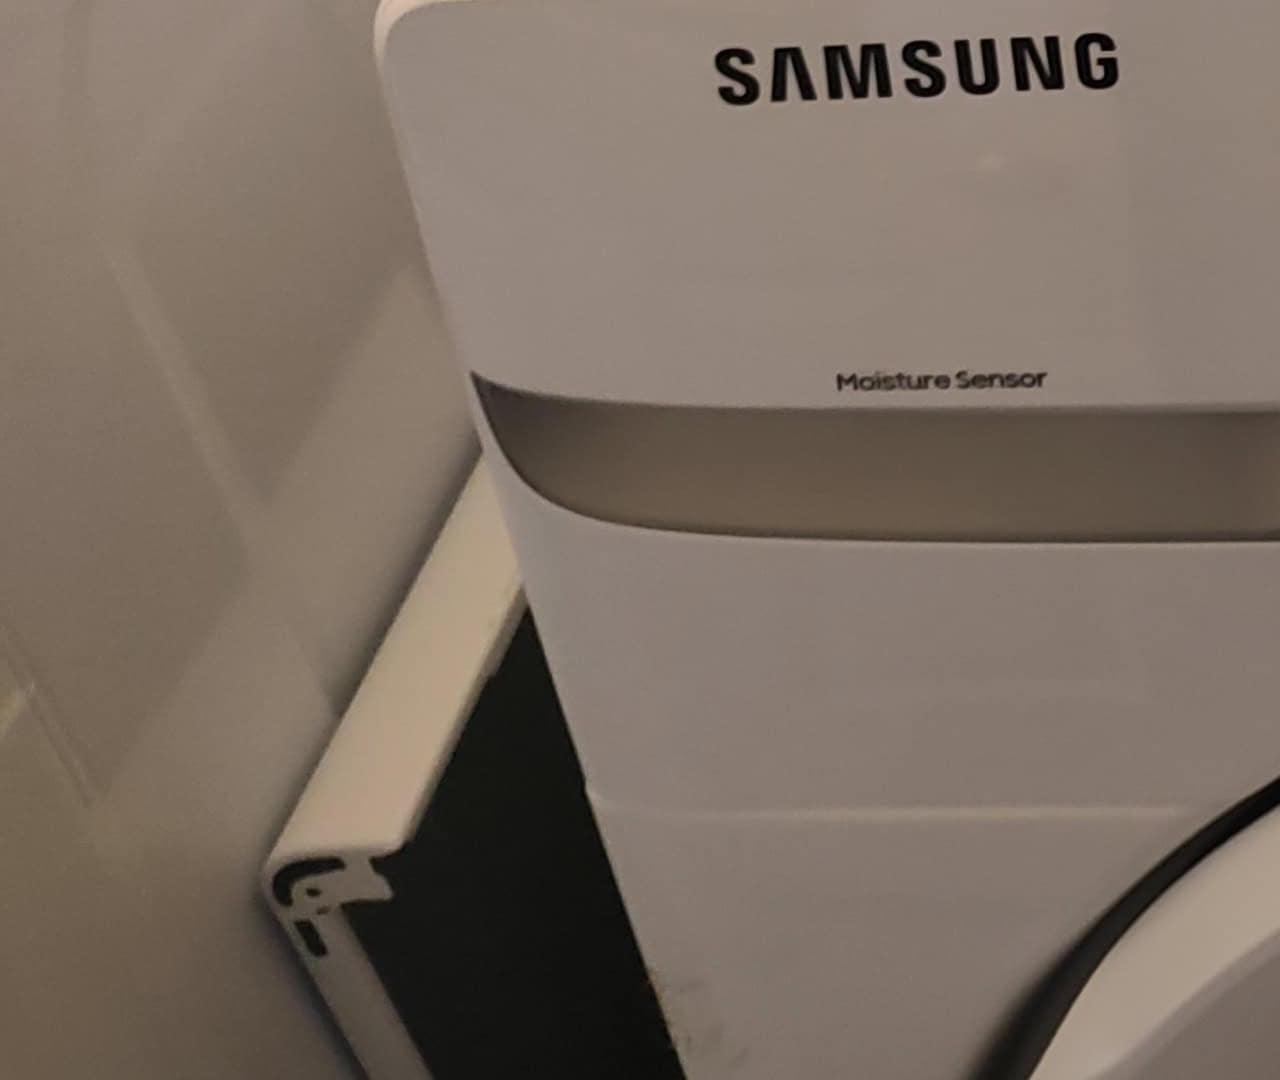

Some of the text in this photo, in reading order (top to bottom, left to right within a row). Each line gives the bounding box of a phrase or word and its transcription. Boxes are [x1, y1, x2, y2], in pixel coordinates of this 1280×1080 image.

[714, 32, 1120, 106] SAMSUNG
[836, 370, 1047, 392] Moisture Sensor
